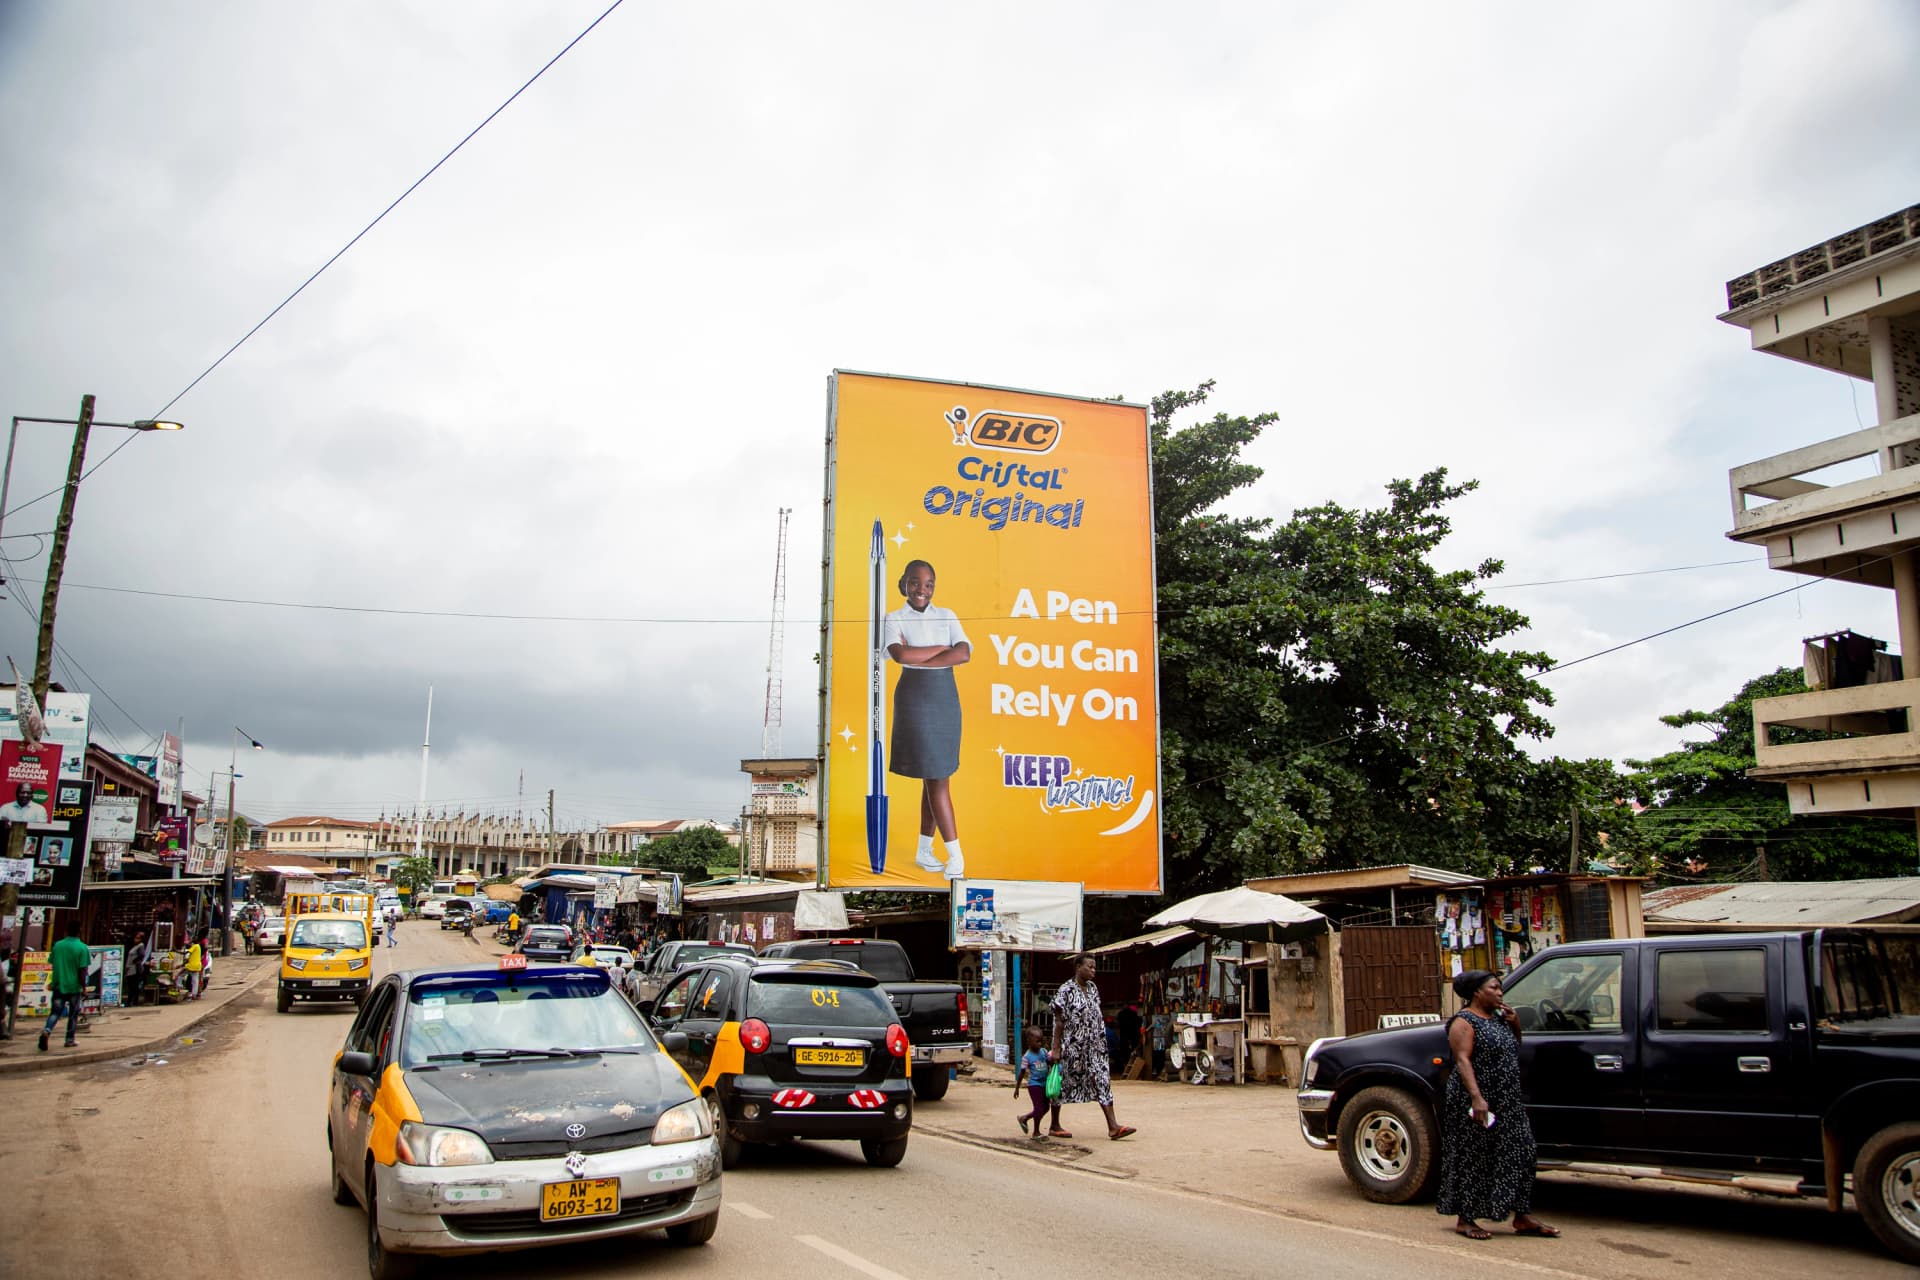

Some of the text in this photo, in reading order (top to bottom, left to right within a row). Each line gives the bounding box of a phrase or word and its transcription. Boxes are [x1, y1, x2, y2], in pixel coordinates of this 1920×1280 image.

[923, 485, 1085, 531] Original
[1009, 588, 1118, 625] A Pen
[989, 633, 1139, 673] You Can
[991, 683, 1138, 727] Rely On
[8, 766, 49, 775] DRAMANI
[8, 772, 48, 780] MAHAMA
[1003, 753, 1071, 788] KEEP
[1046, 775, 1134, 809] WRITING!
[502, 957, 526, 969] TAXI
[1789, 1022, 1807, 1031] LS
[801, 1051, 813, 1061] GE
[568, 1181, 588, 1198] AW
[548, 1196, 613, 1217] 6093-12
